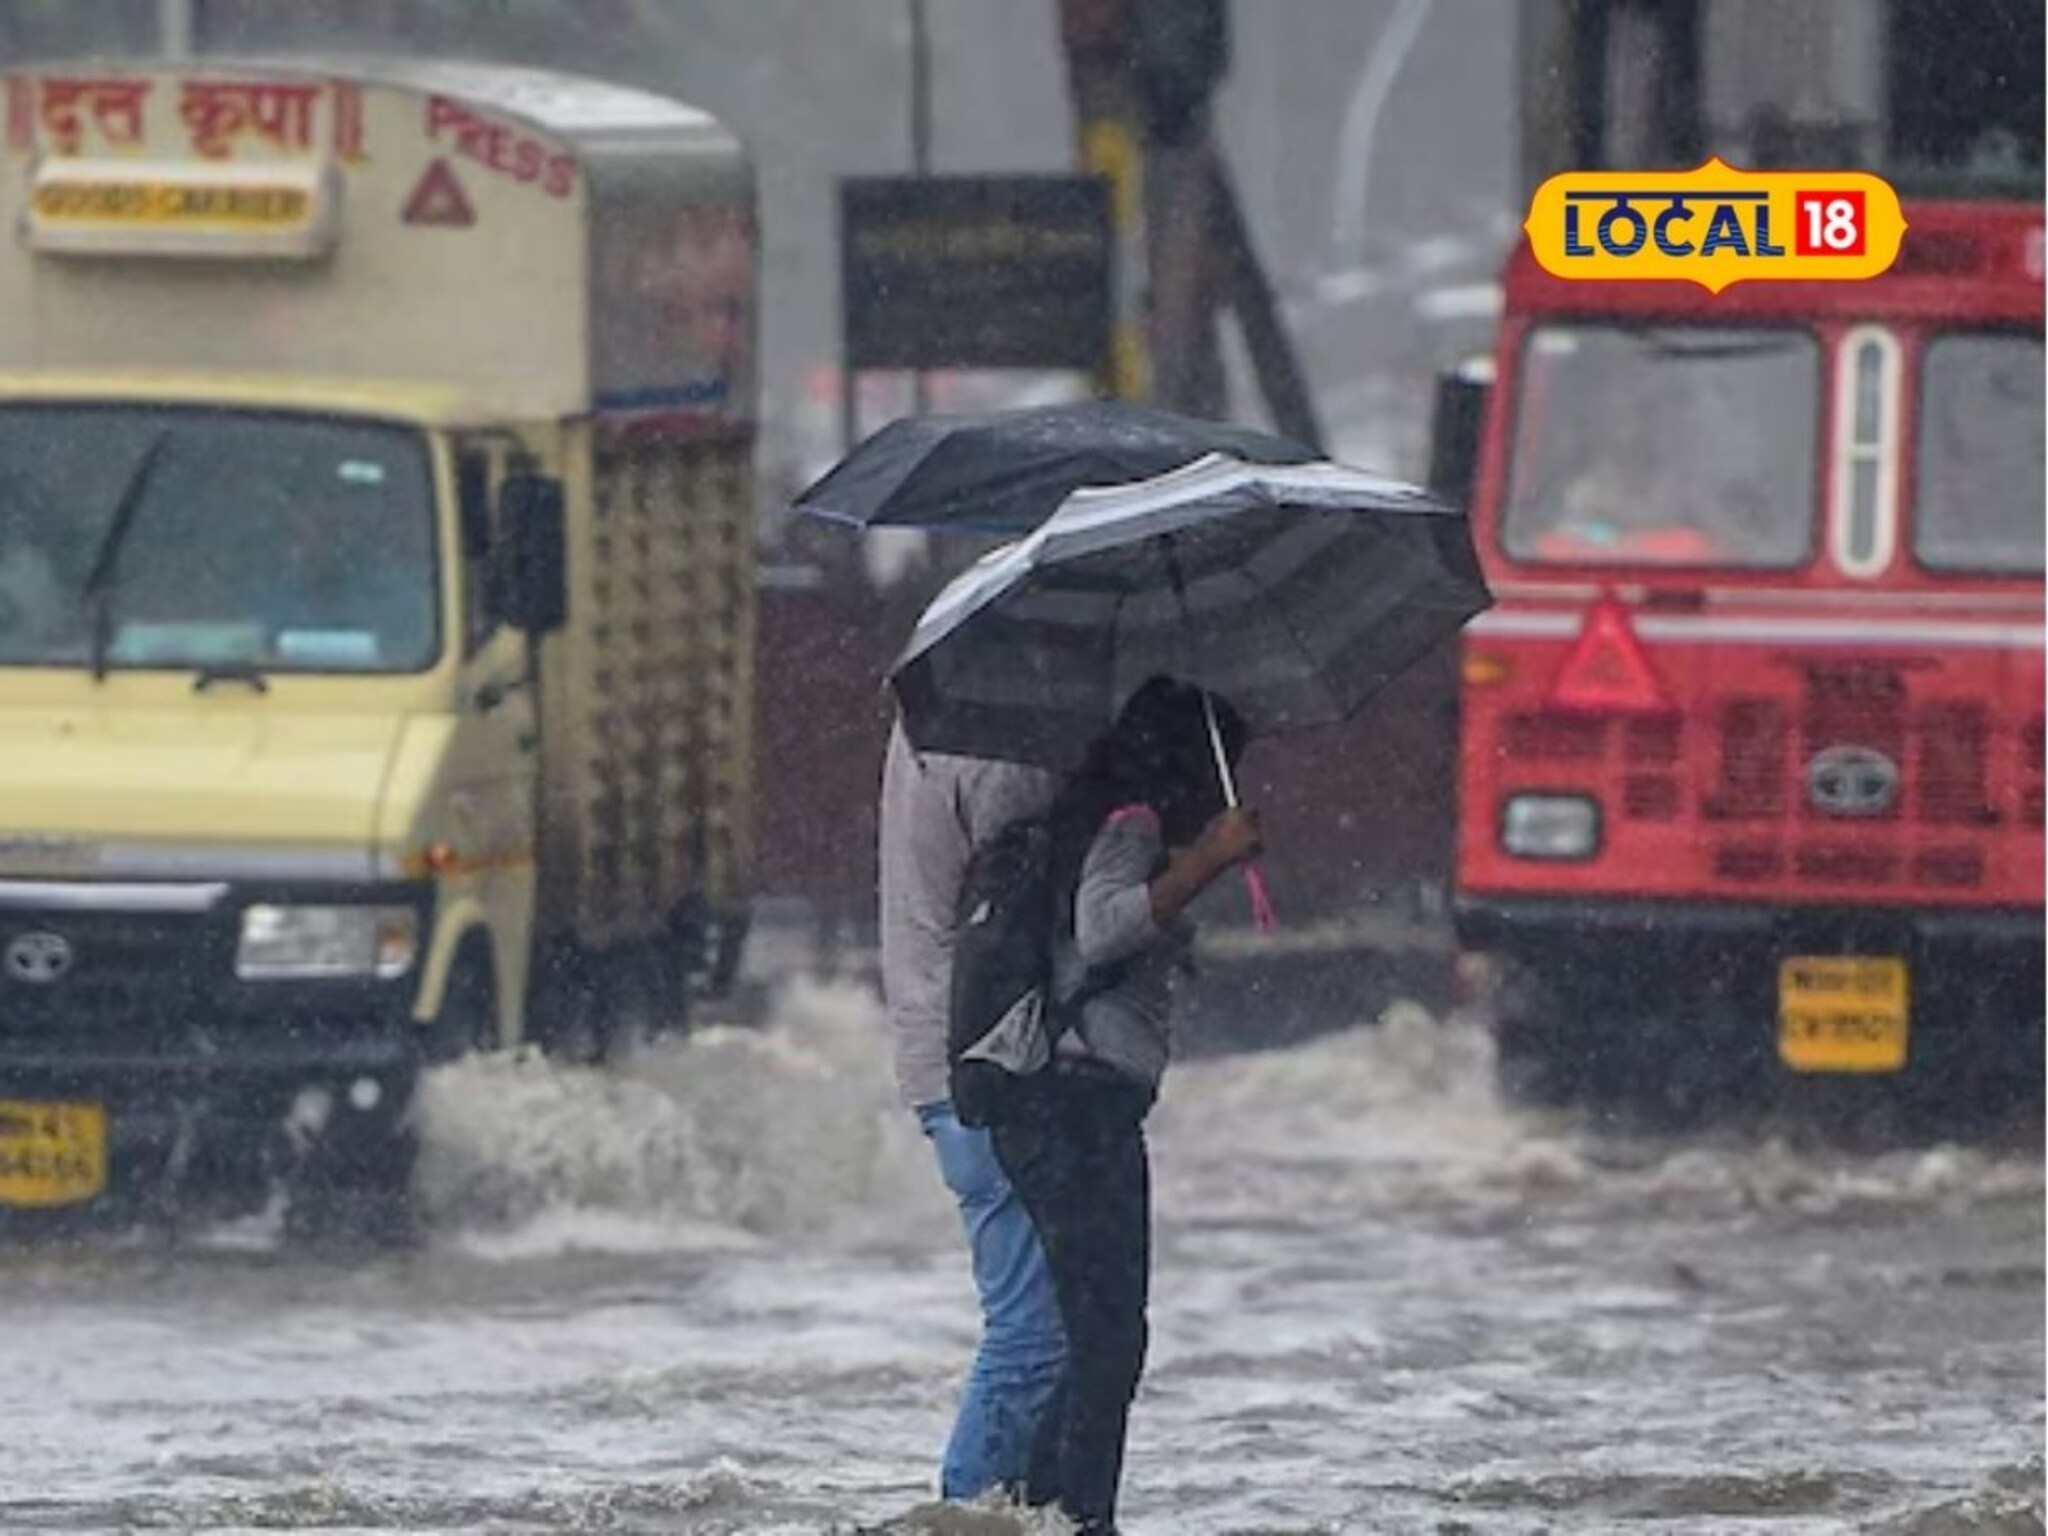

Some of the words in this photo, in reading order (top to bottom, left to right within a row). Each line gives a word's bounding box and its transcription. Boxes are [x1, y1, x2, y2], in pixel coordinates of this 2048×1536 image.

[424, 93, 577, 198] PRESS
[34, 181, 152, 217] GOODS
[156, 184, 311, 221] CARRIER
